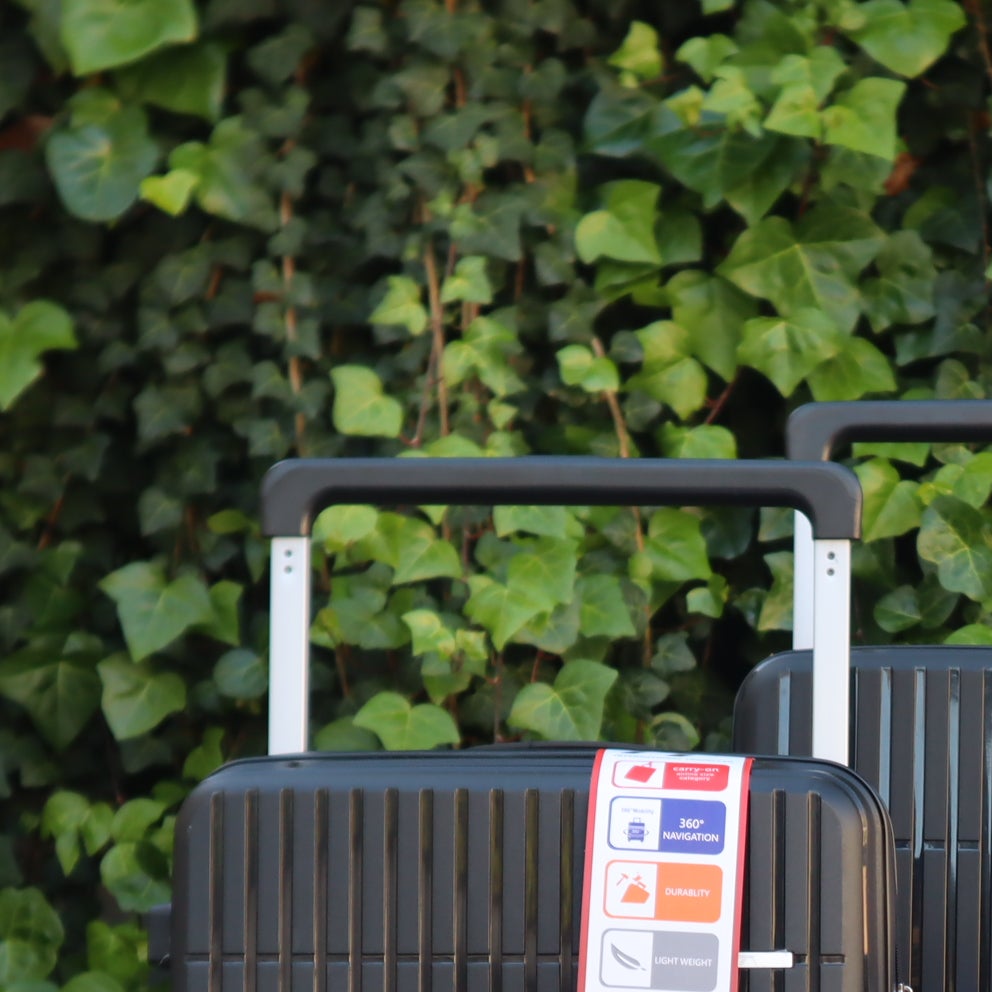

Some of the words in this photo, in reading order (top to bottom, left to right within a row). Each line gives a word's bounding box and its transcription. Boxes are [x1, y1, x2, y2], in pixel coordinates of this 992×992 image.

[679, 818, 704, 829] 360°
[662, 831, 719, 842] NAVIGATION
[665, 888, 710, 897] DURABLITY
[655, 956, 678, 966] LIGHT
[680, 958, 712, 968] WEIGHT
